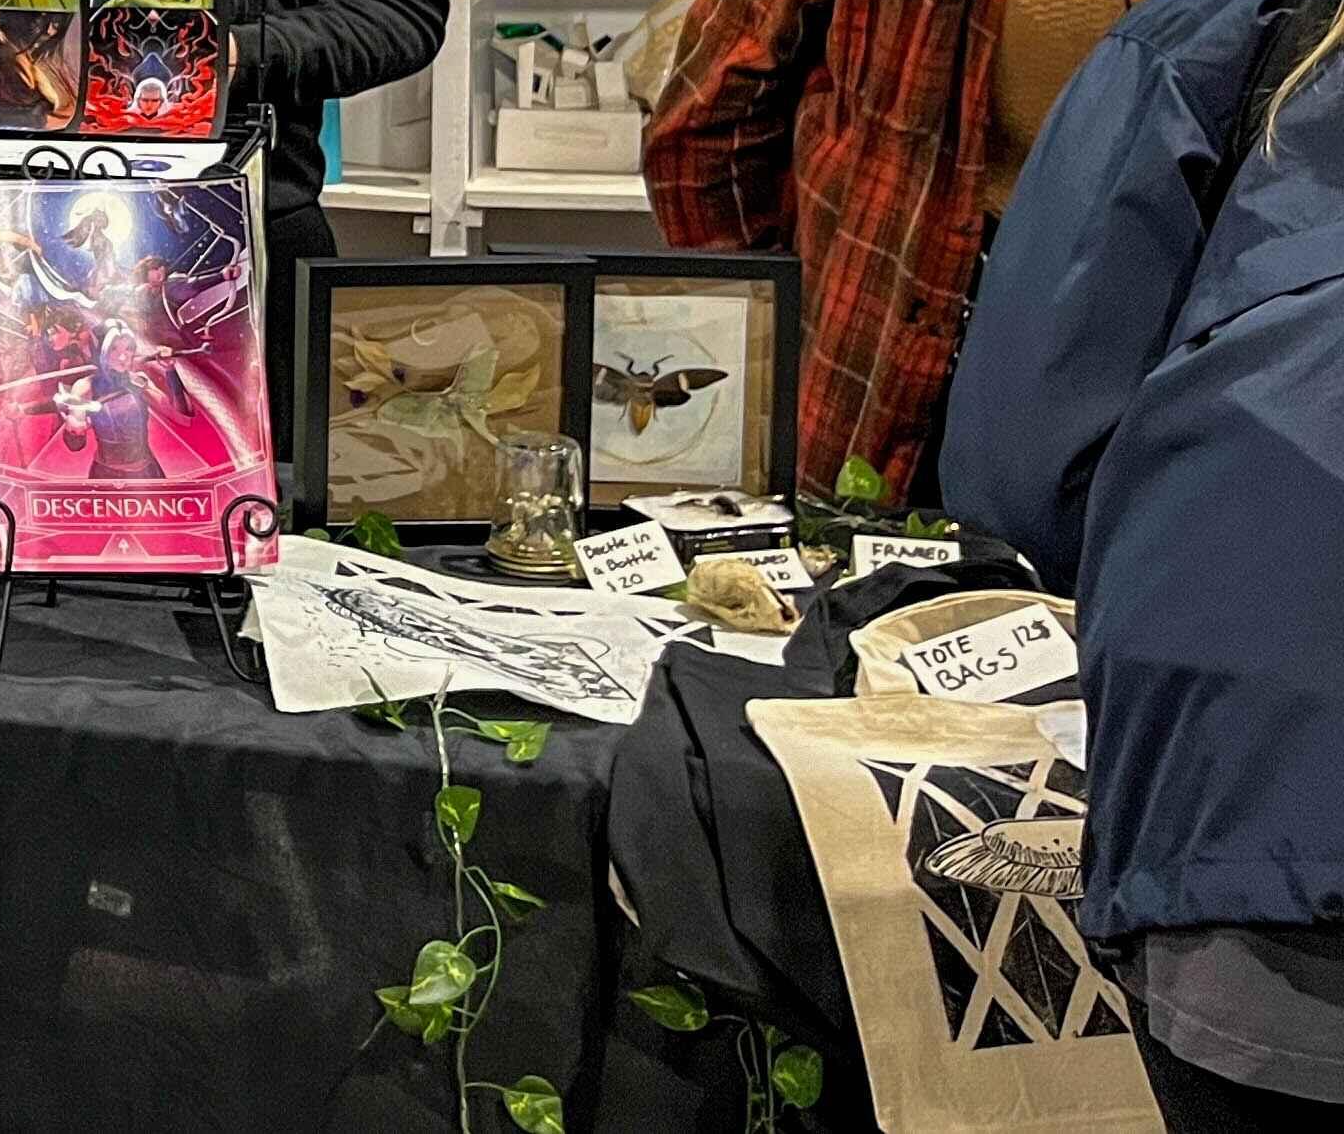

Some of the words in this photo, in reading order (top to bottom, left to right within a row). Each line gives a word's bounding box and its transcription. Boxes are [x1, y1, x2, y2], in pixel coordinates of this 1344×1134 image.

[33, 496, 209, 518] DESCENDANCY
[633, 531, 650, 548] in
[871, 541, 950, 563] FRAMED
[605, 572, 644, 593] $20
[914, 634, 973, 668] TOTE
[934, 647, 1018, 692] BAGS
